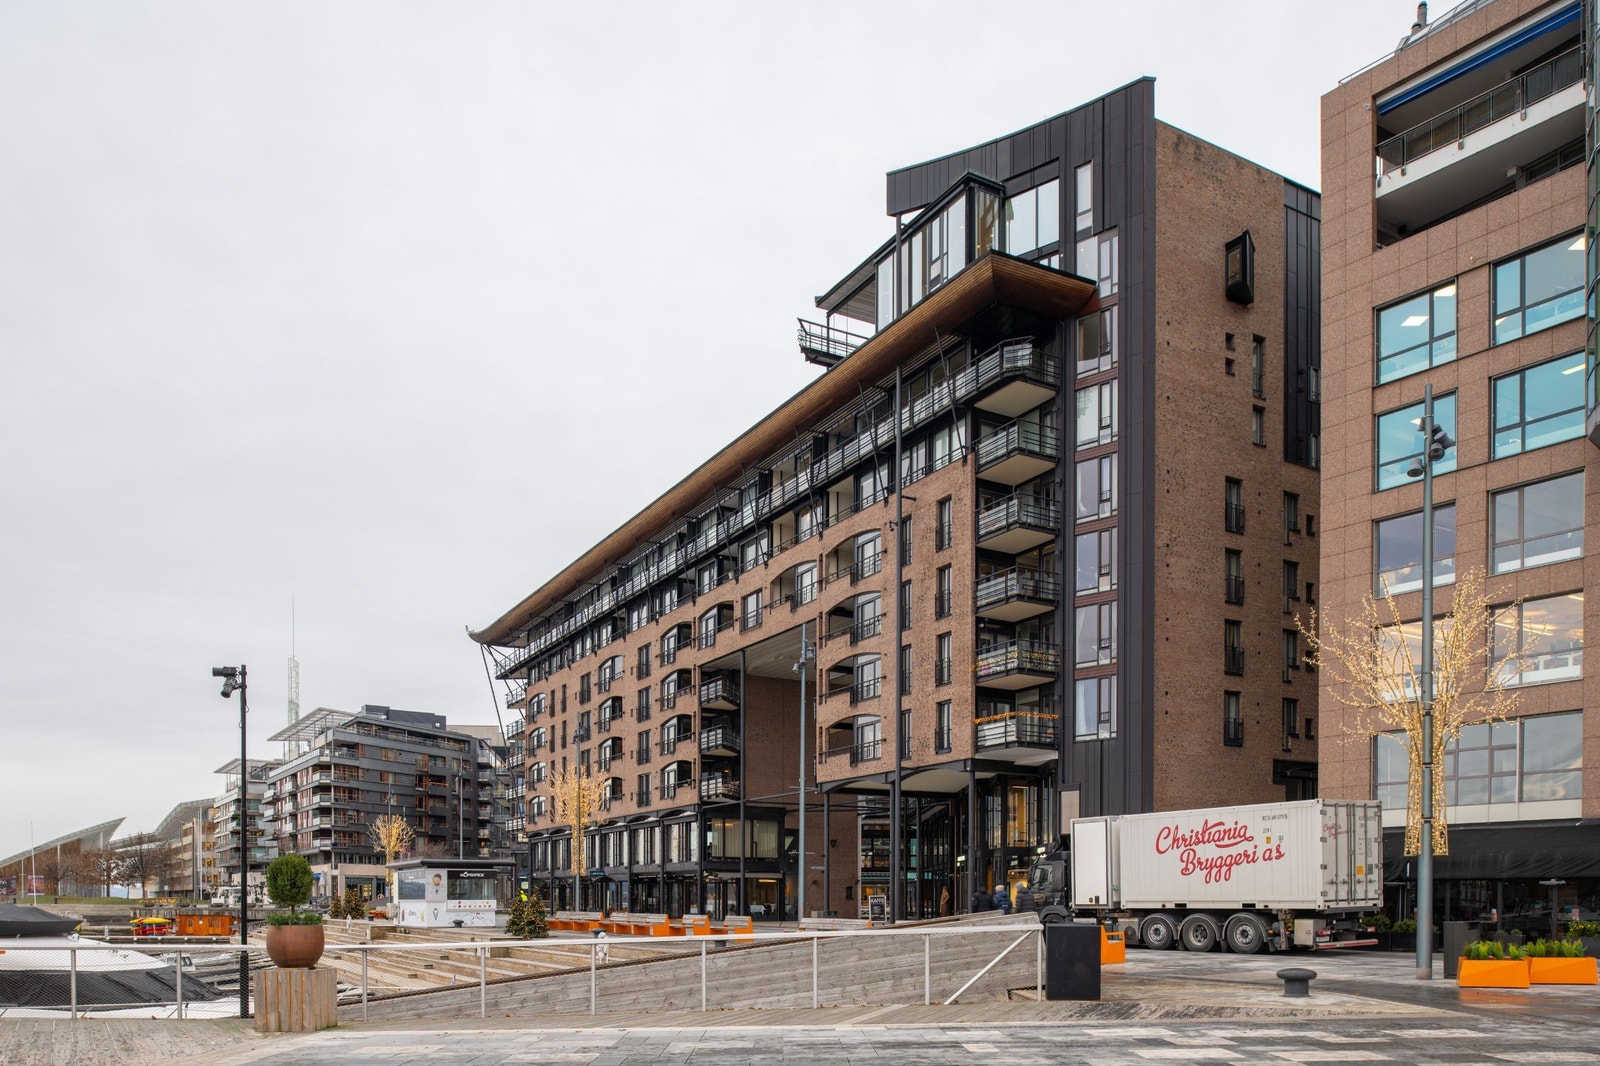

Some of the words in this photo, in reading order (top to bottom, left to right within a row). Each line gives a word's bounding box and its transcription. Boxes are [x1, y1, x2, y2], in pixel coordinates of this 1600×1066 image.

[1155, 818, 1254, 855] Christiania
[1180, 844, 1259, 884] Bryggeri
[1262, 843, 1285, 861] as
